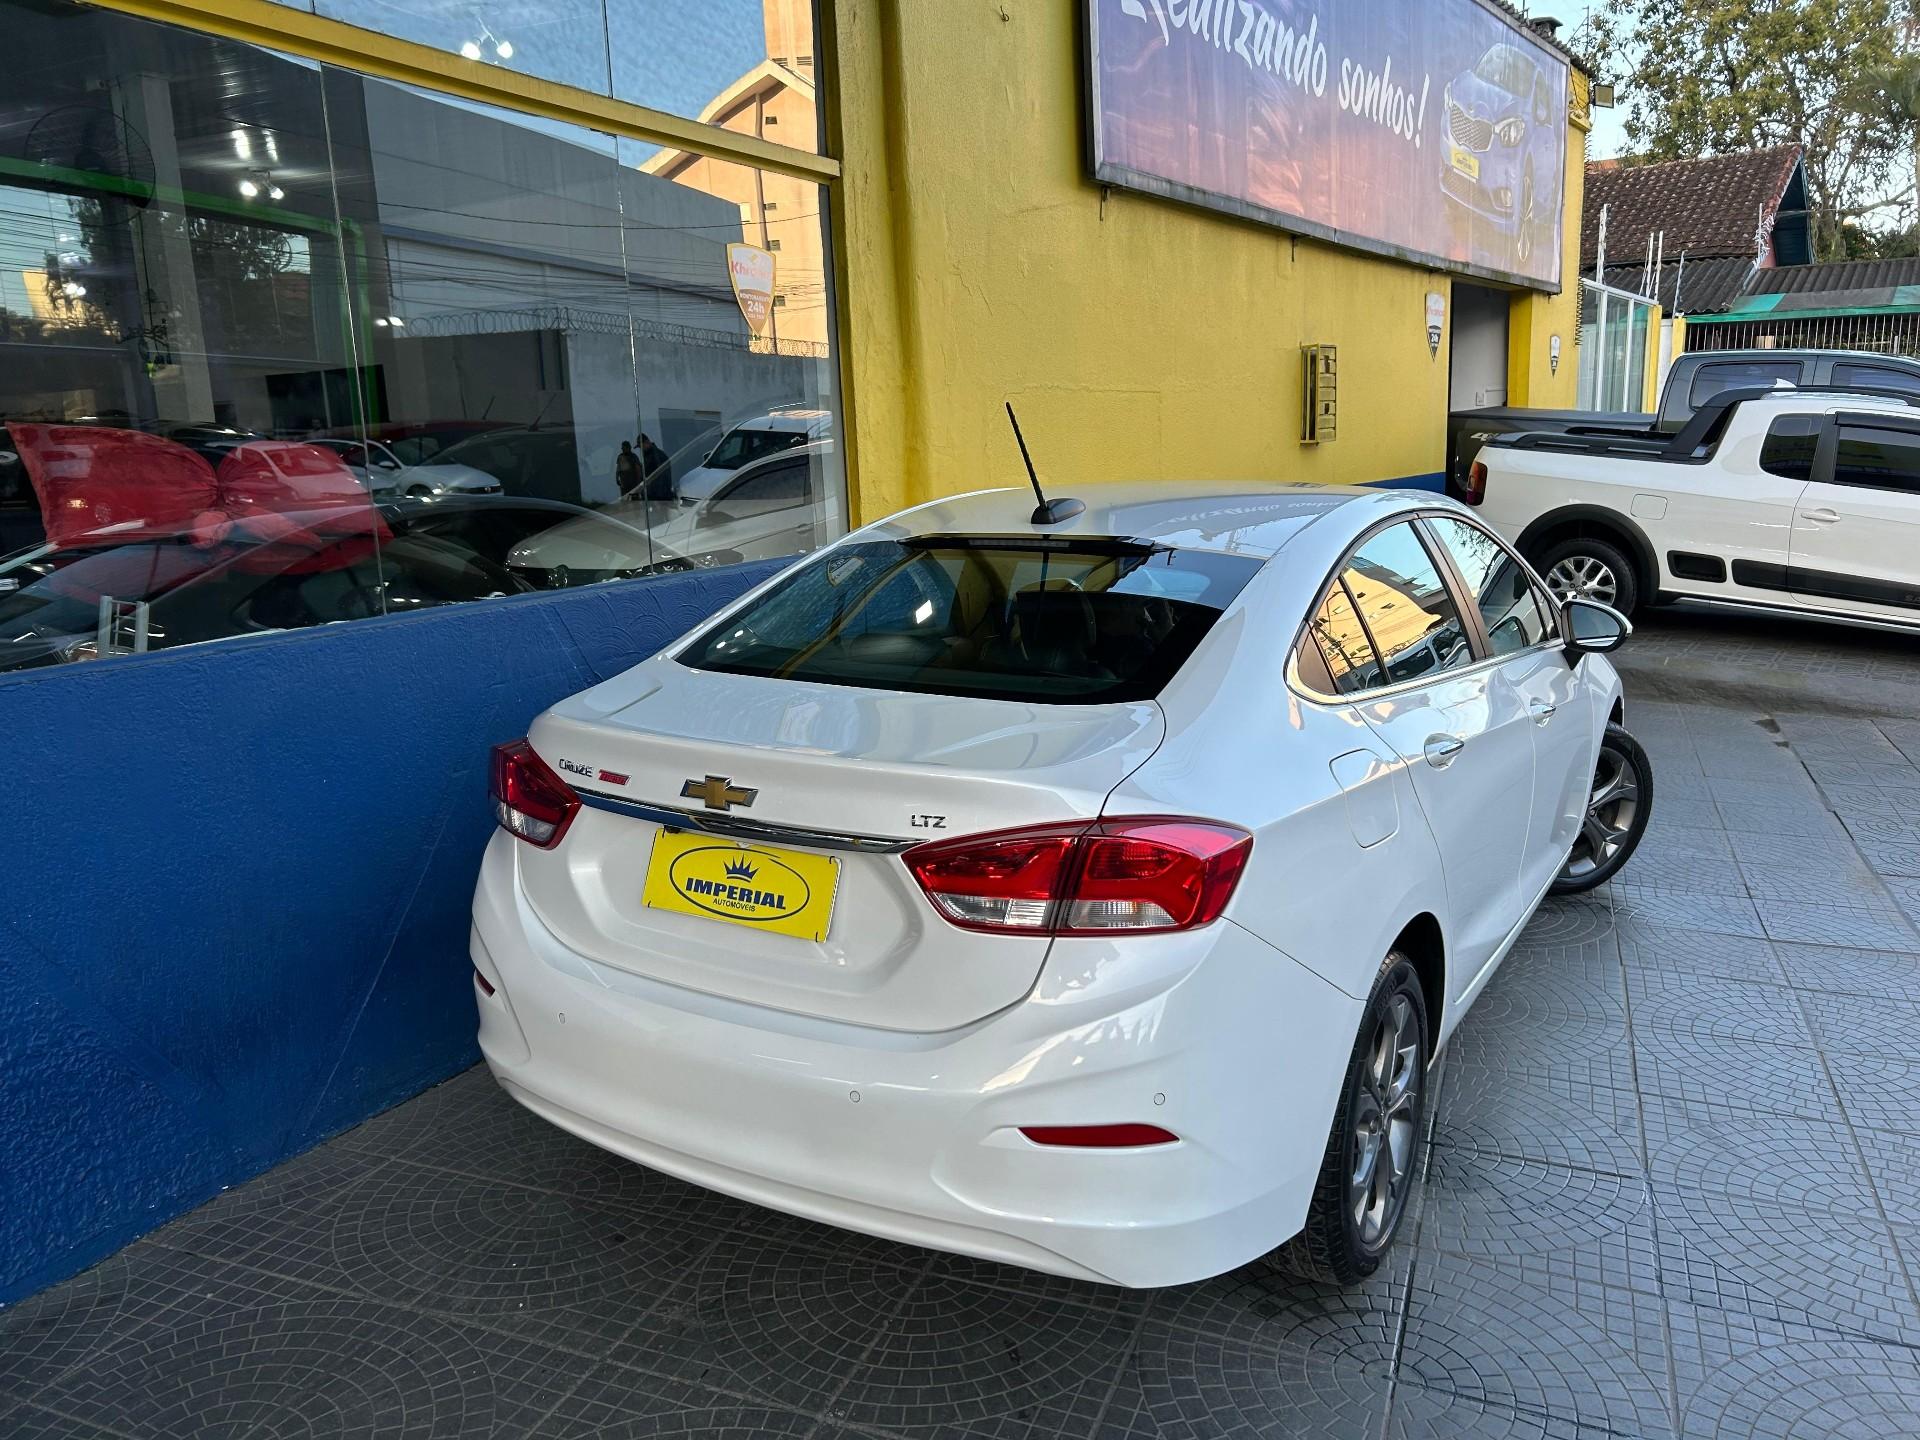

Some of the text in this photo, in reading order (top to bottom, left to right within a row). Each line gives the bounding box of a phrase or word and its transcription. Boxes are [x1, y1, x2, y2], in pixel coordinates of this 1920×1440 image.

[1338, 54, 1430, 149] sonhos!
[911, 814, 947, 829] LTZ
[685, 877, 786, 910] IMPERIAL
